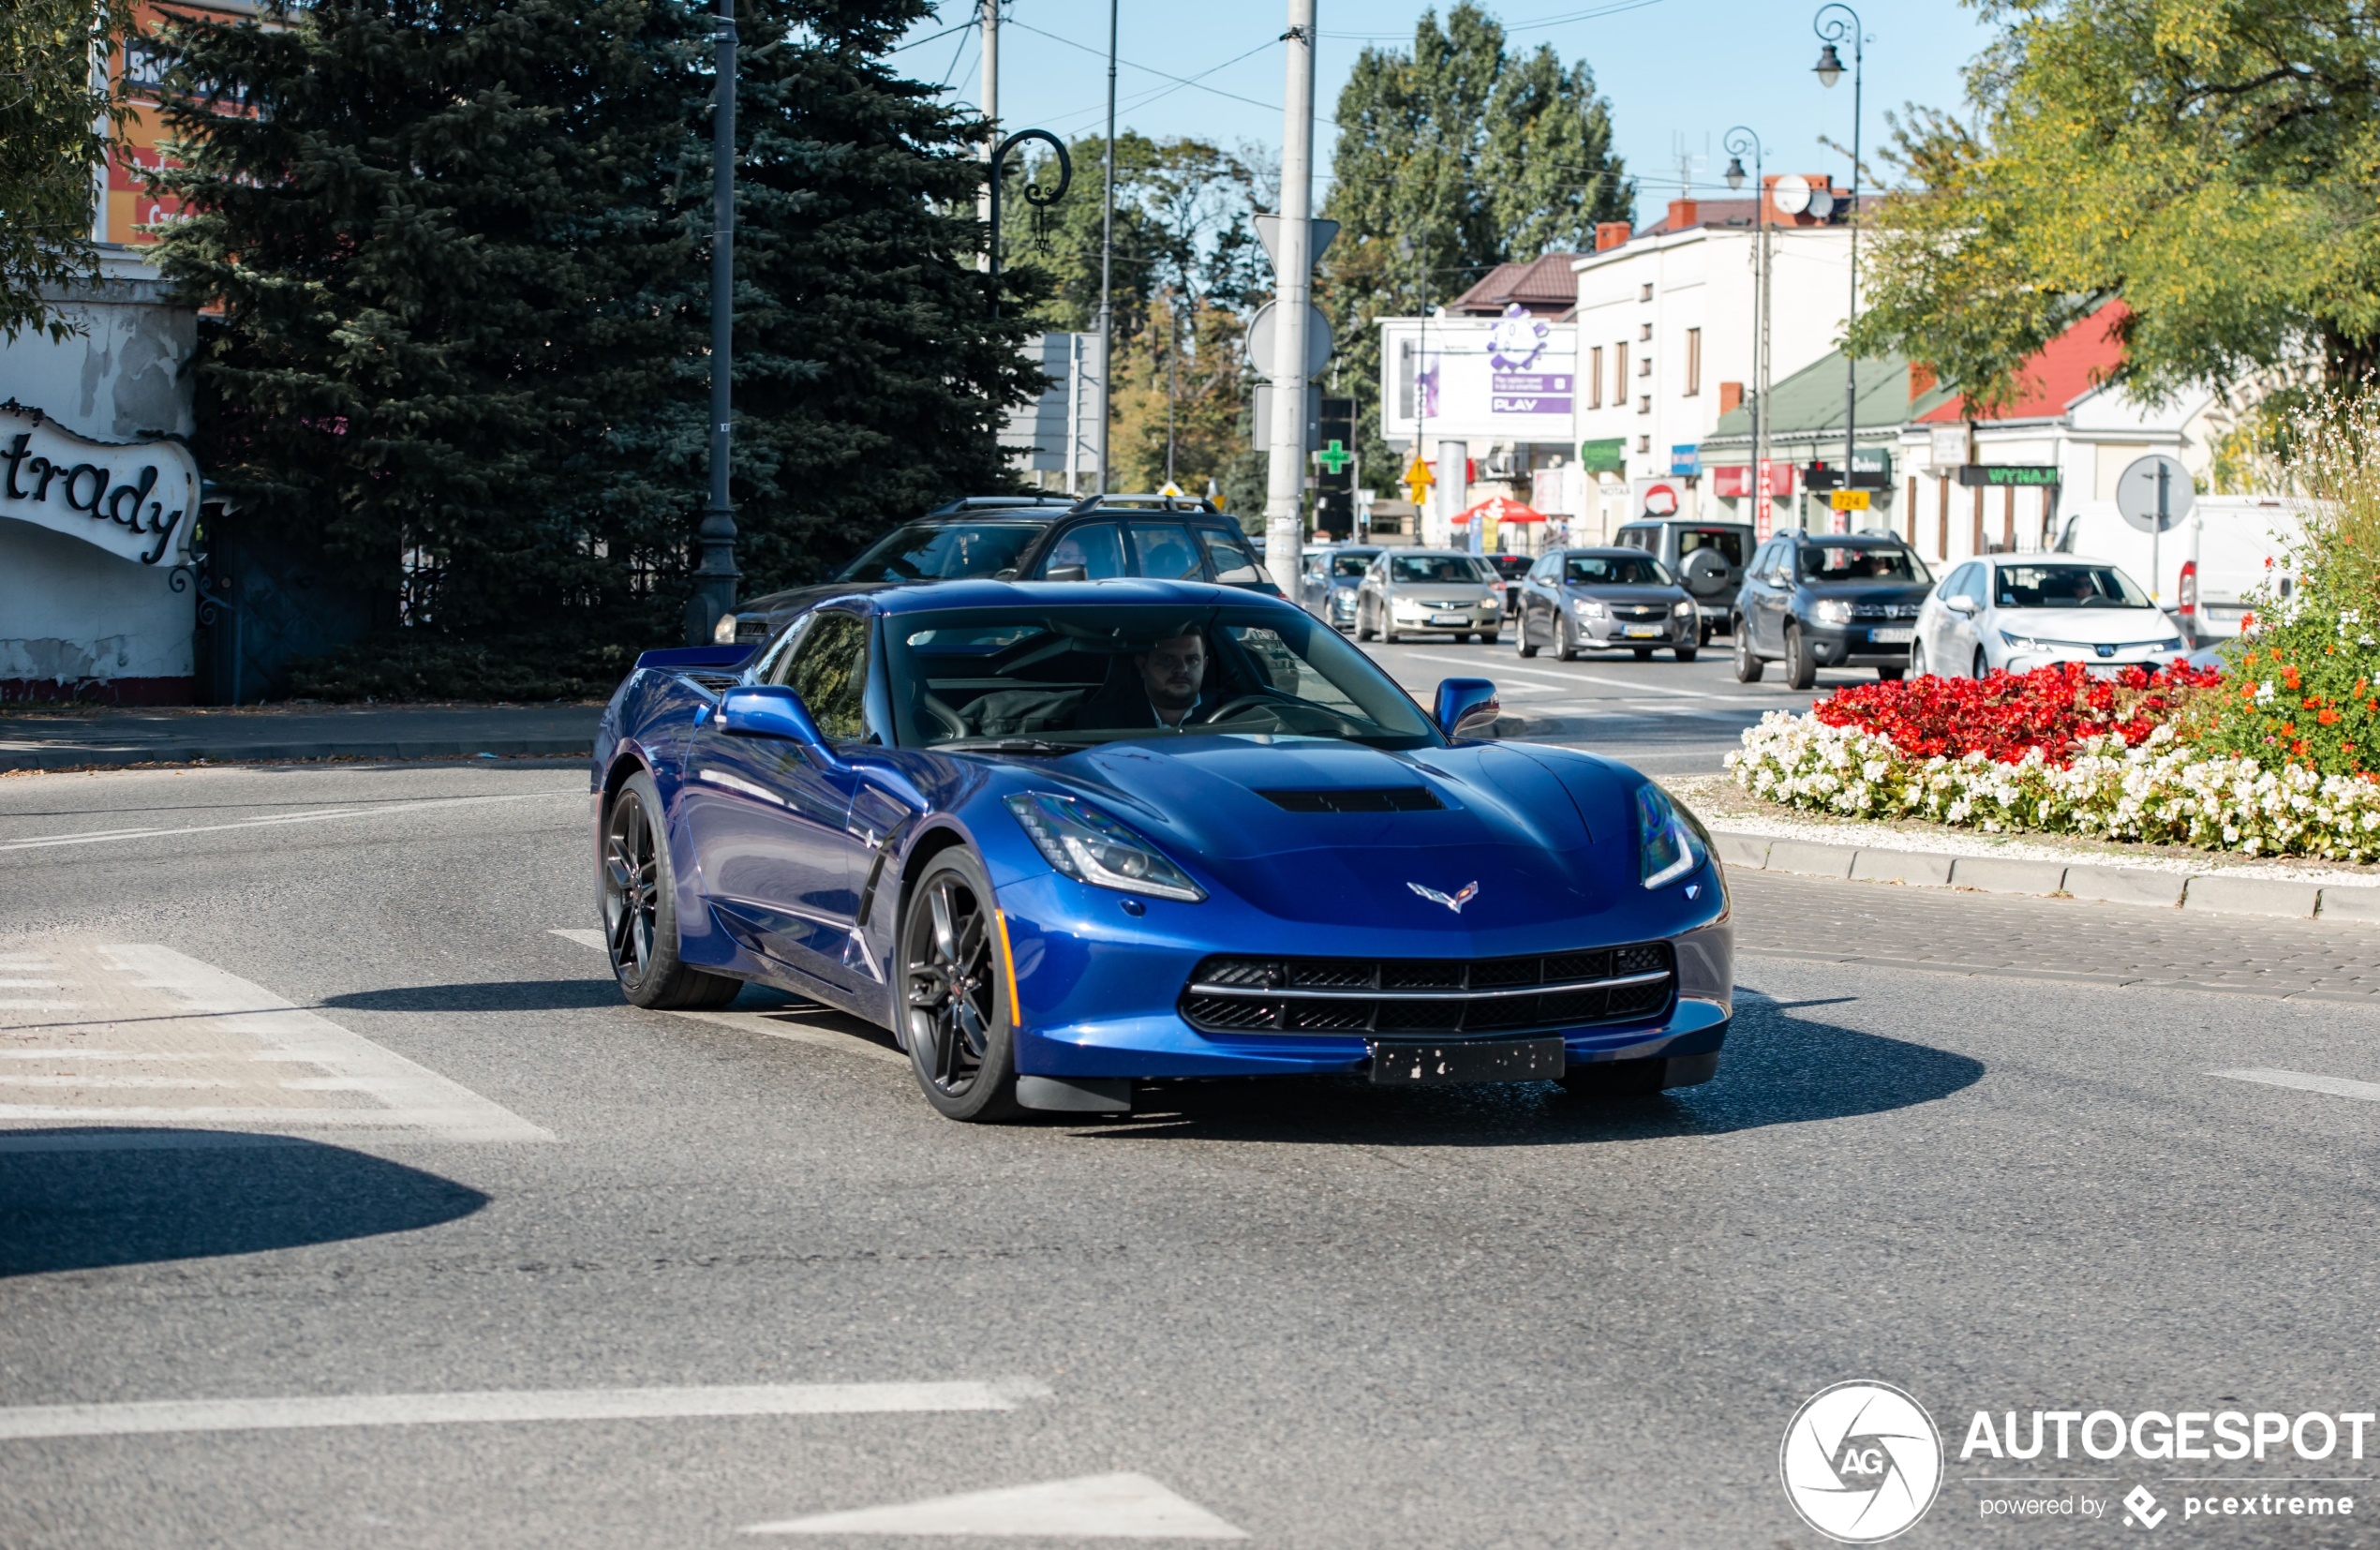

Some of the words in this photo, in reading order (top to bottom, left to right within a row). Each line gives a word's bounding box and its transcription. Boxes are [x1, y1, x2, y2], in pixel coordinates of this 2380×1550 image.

[1494, 398, 1538, 411] PLAY
[1, 433, 183, 564] trady
[1837, 494, 1861, 507] 724
